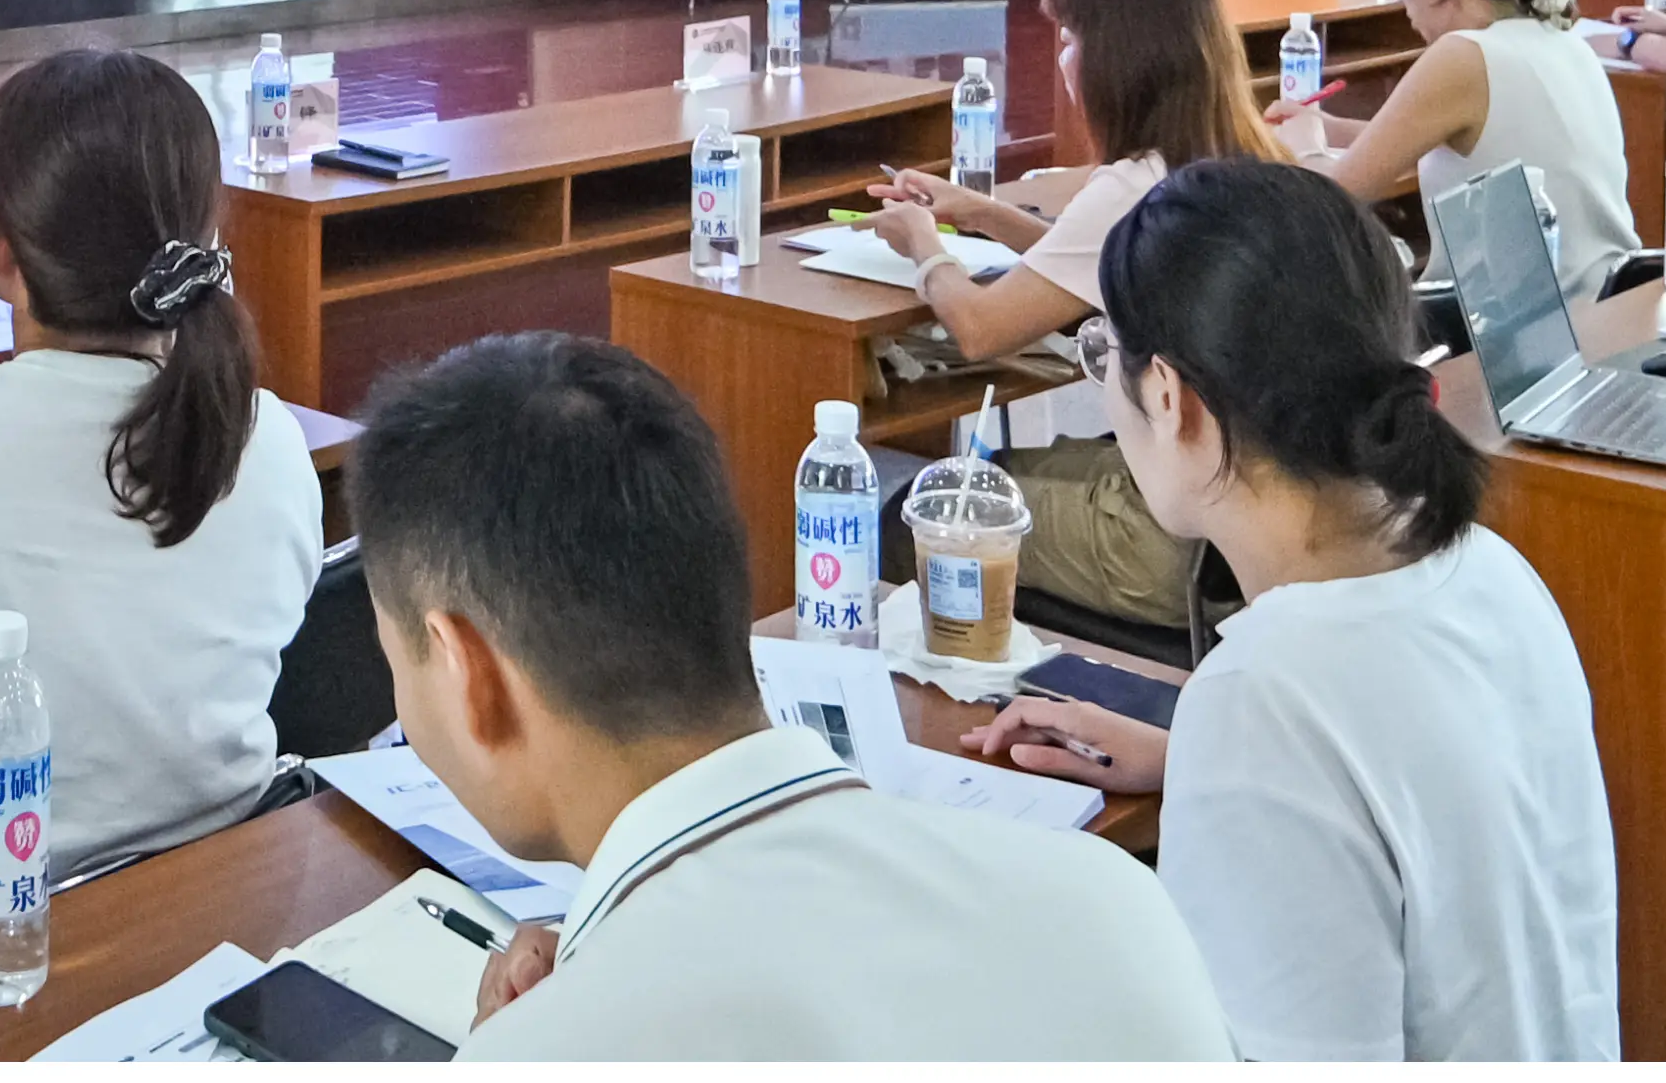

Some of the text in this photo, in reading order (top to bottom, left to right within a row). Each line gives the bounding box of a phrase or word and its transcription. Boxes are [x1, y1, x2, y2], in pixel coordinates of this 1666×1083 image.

[797, 507, 863, 546] 弱碱性
[797, 592, 863, 631] 矿泉水
